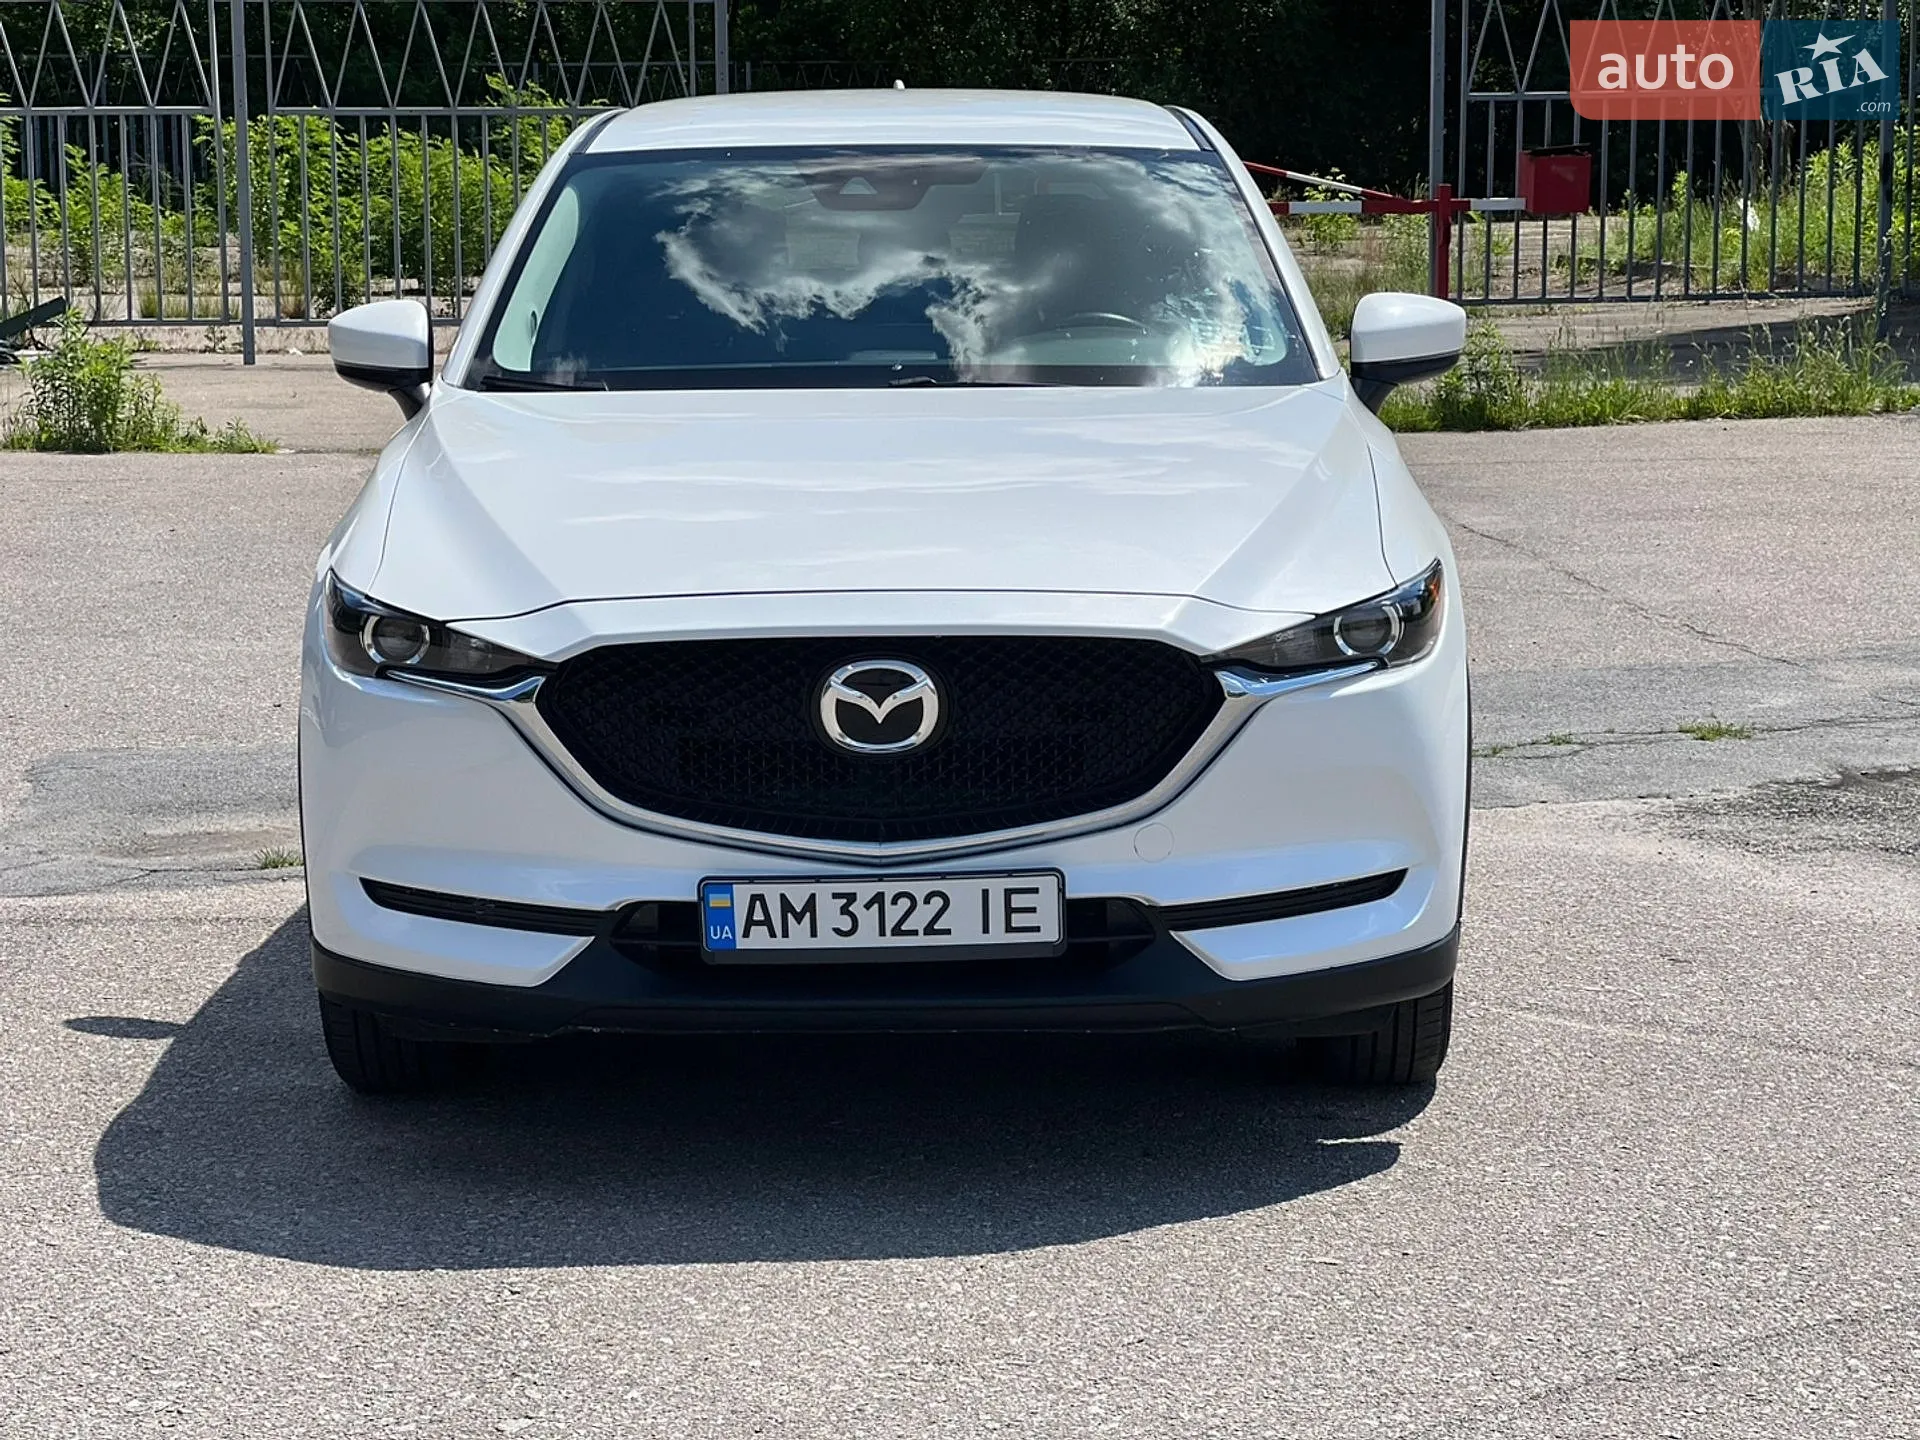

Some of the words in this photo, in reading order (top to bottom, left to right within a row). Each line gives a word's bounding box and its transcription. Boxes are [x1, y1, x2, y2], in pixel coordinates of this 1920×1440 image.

[742, 892, 818, 939] AM
[831, 890, 952, 937] 3122
[982, 887, 1041, 935] IE
[710, 925, 733, 940] UA
